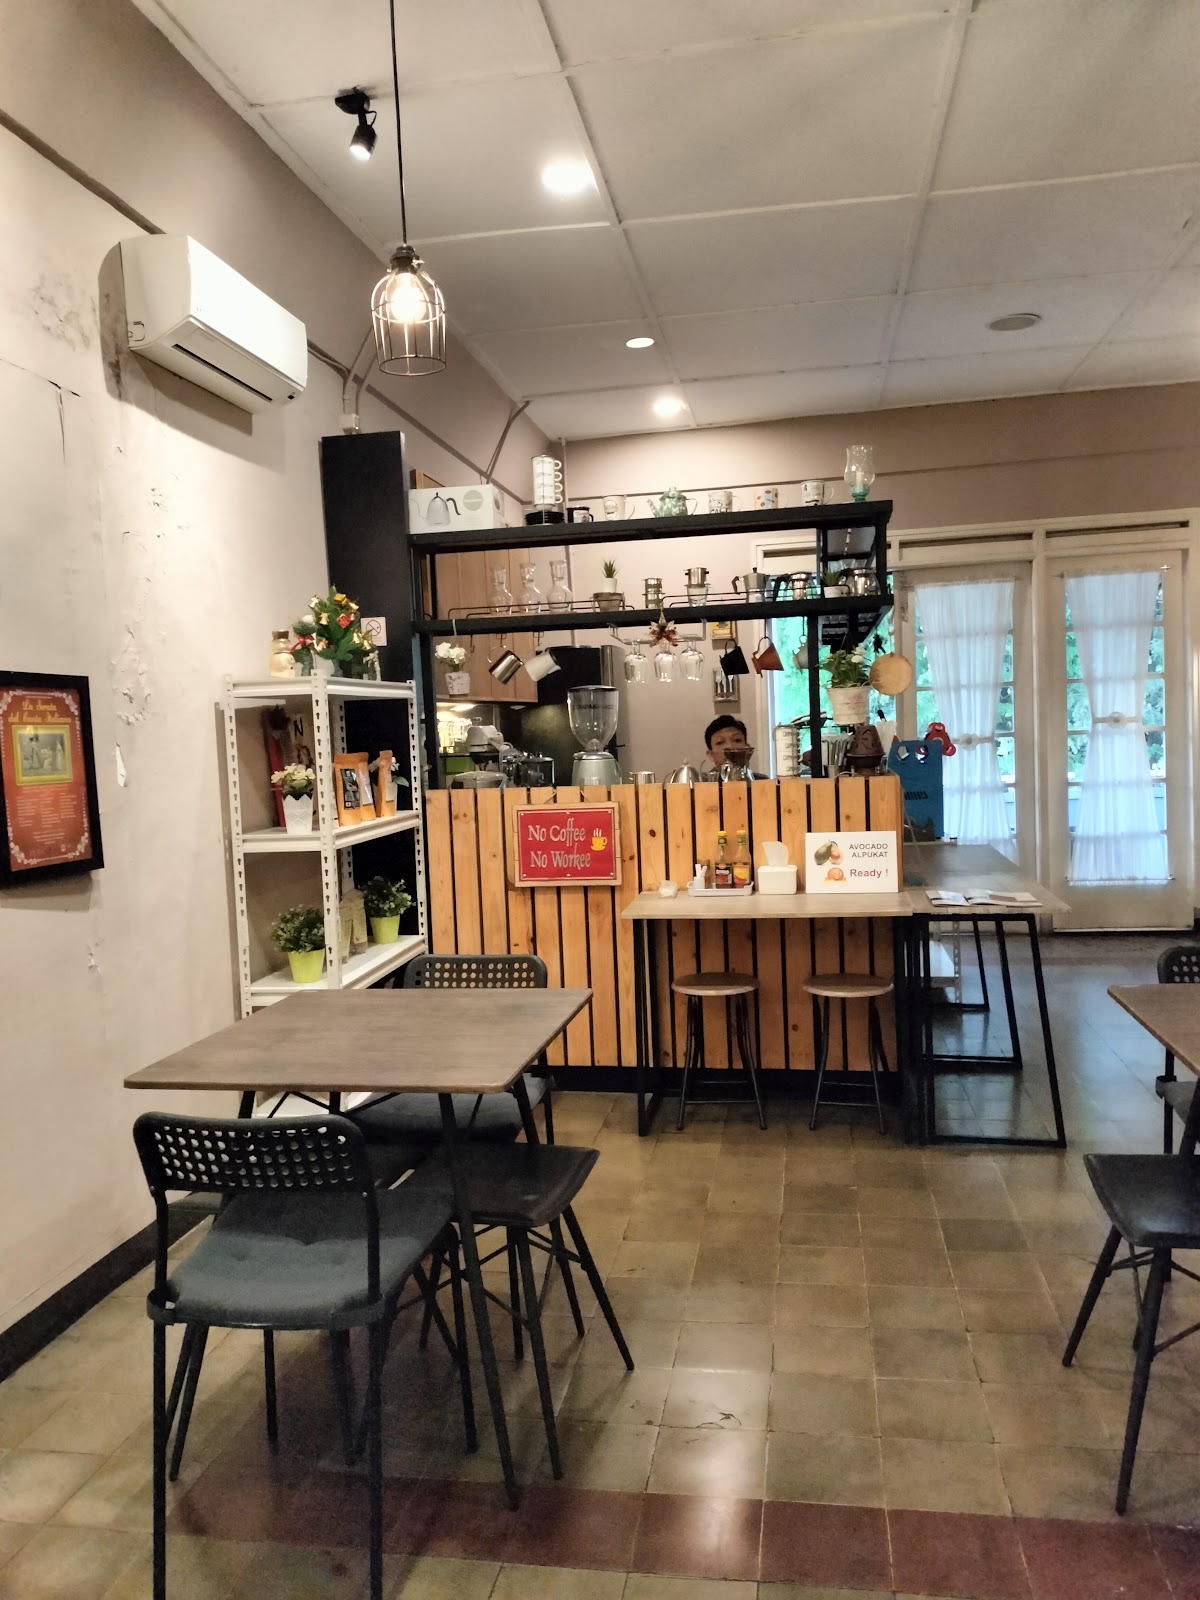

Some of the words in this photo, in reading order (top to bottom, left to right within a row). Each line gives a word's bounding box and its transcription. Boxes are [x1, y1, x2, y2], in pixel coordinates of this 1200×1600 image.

[527, 825, 546, 841] No
[549, 818, 586, 847] Coffee
[530, 850, 548, 868] No
[551, 843, 591, 870] Workee
[850, 868, 882, 878] Ready
